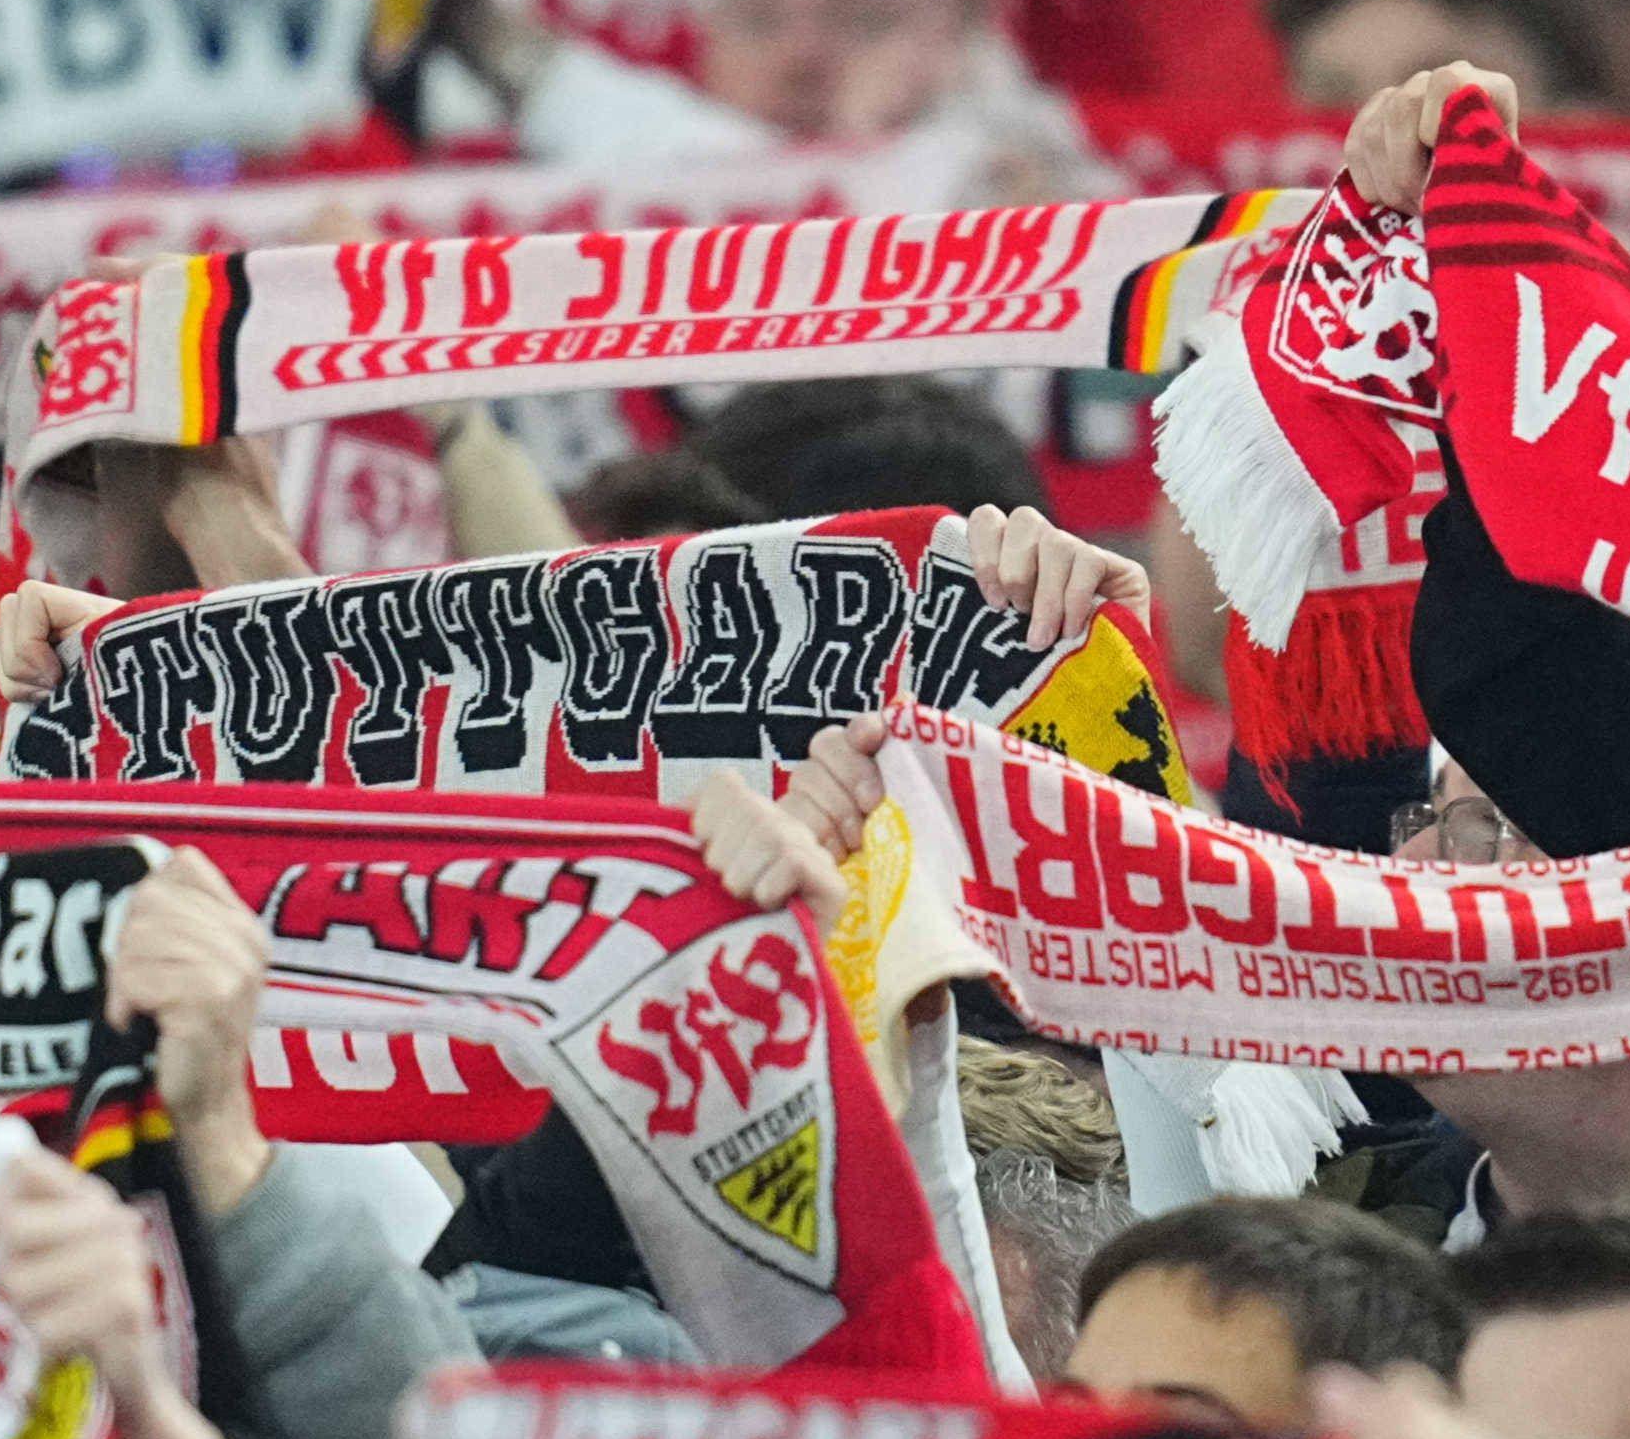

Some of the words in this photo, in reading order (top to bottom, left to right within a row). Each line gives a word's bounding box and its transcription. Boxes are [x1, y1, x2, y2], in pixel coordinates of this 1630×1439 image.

[514, 321, 691, 366] SUPER
[714, 311, 858, 354] FANS
[1026, 927, 1216, 994] MEISTER
